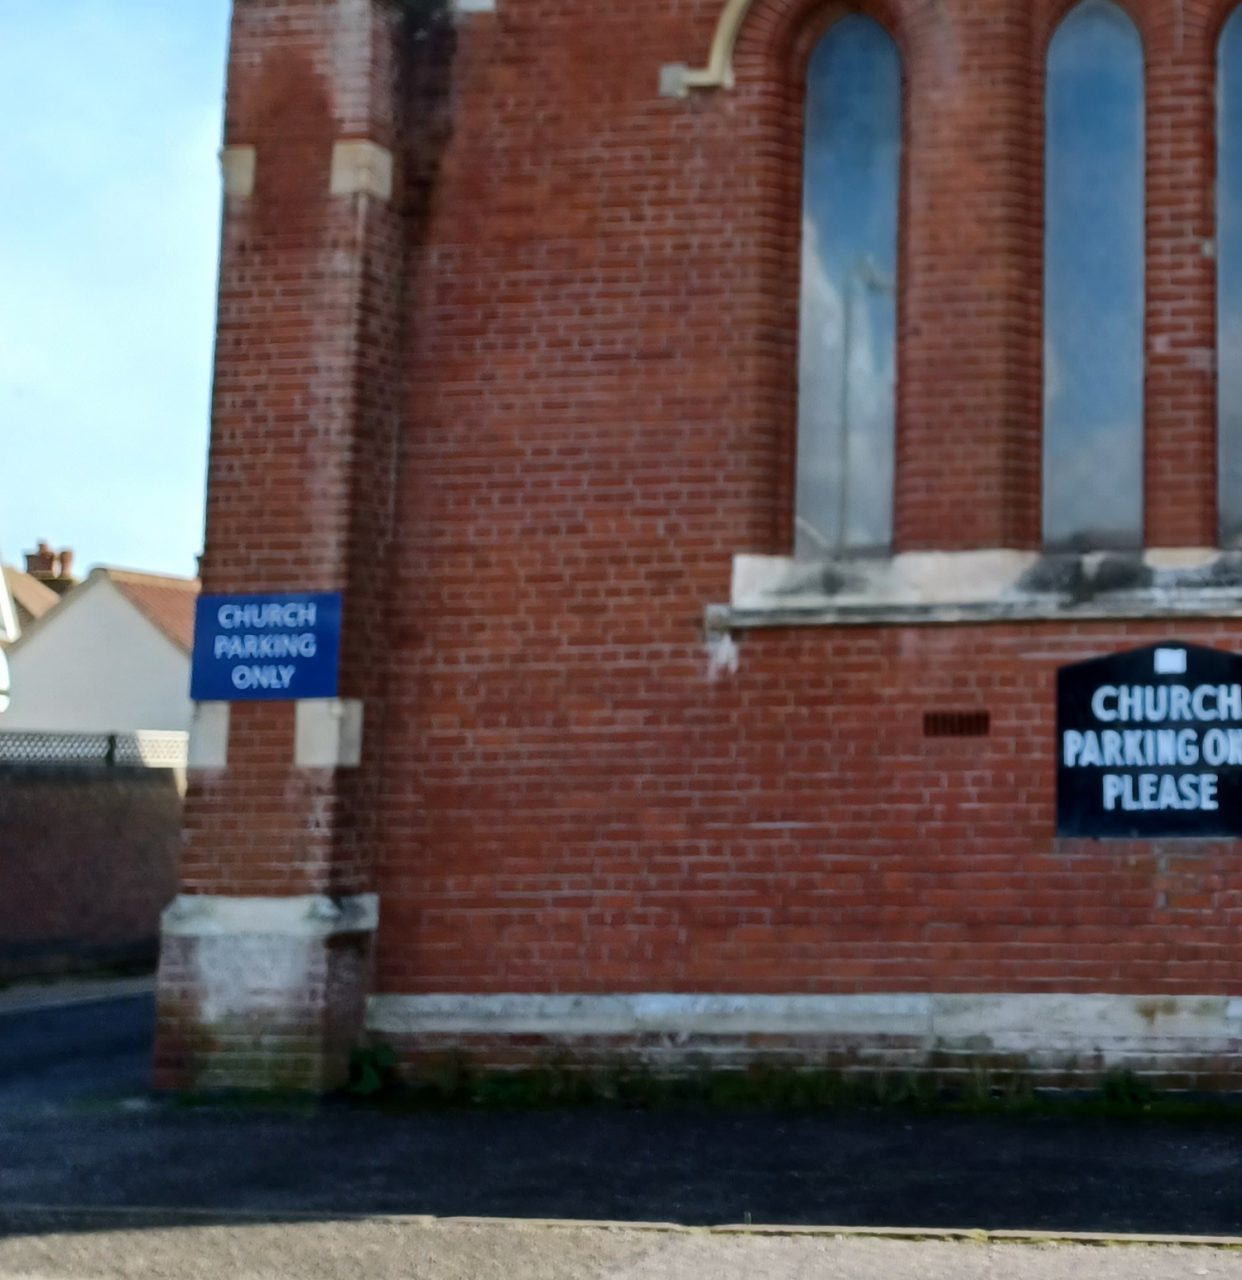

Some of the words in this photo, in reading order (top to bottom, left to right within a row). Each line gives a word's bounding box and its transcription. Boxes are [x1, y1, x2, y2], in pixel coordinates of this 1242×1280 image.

[217, 603, 317, 629] CHURCH
[214, 633, 317, 659] PARKING
[231, 665, 296, 689] ONLY
[1091, 684, 1242, 721] CHURCH
[1063, 729, 1198, 767] PARKING
[1102, 774, 1219, 810] PLEASE
